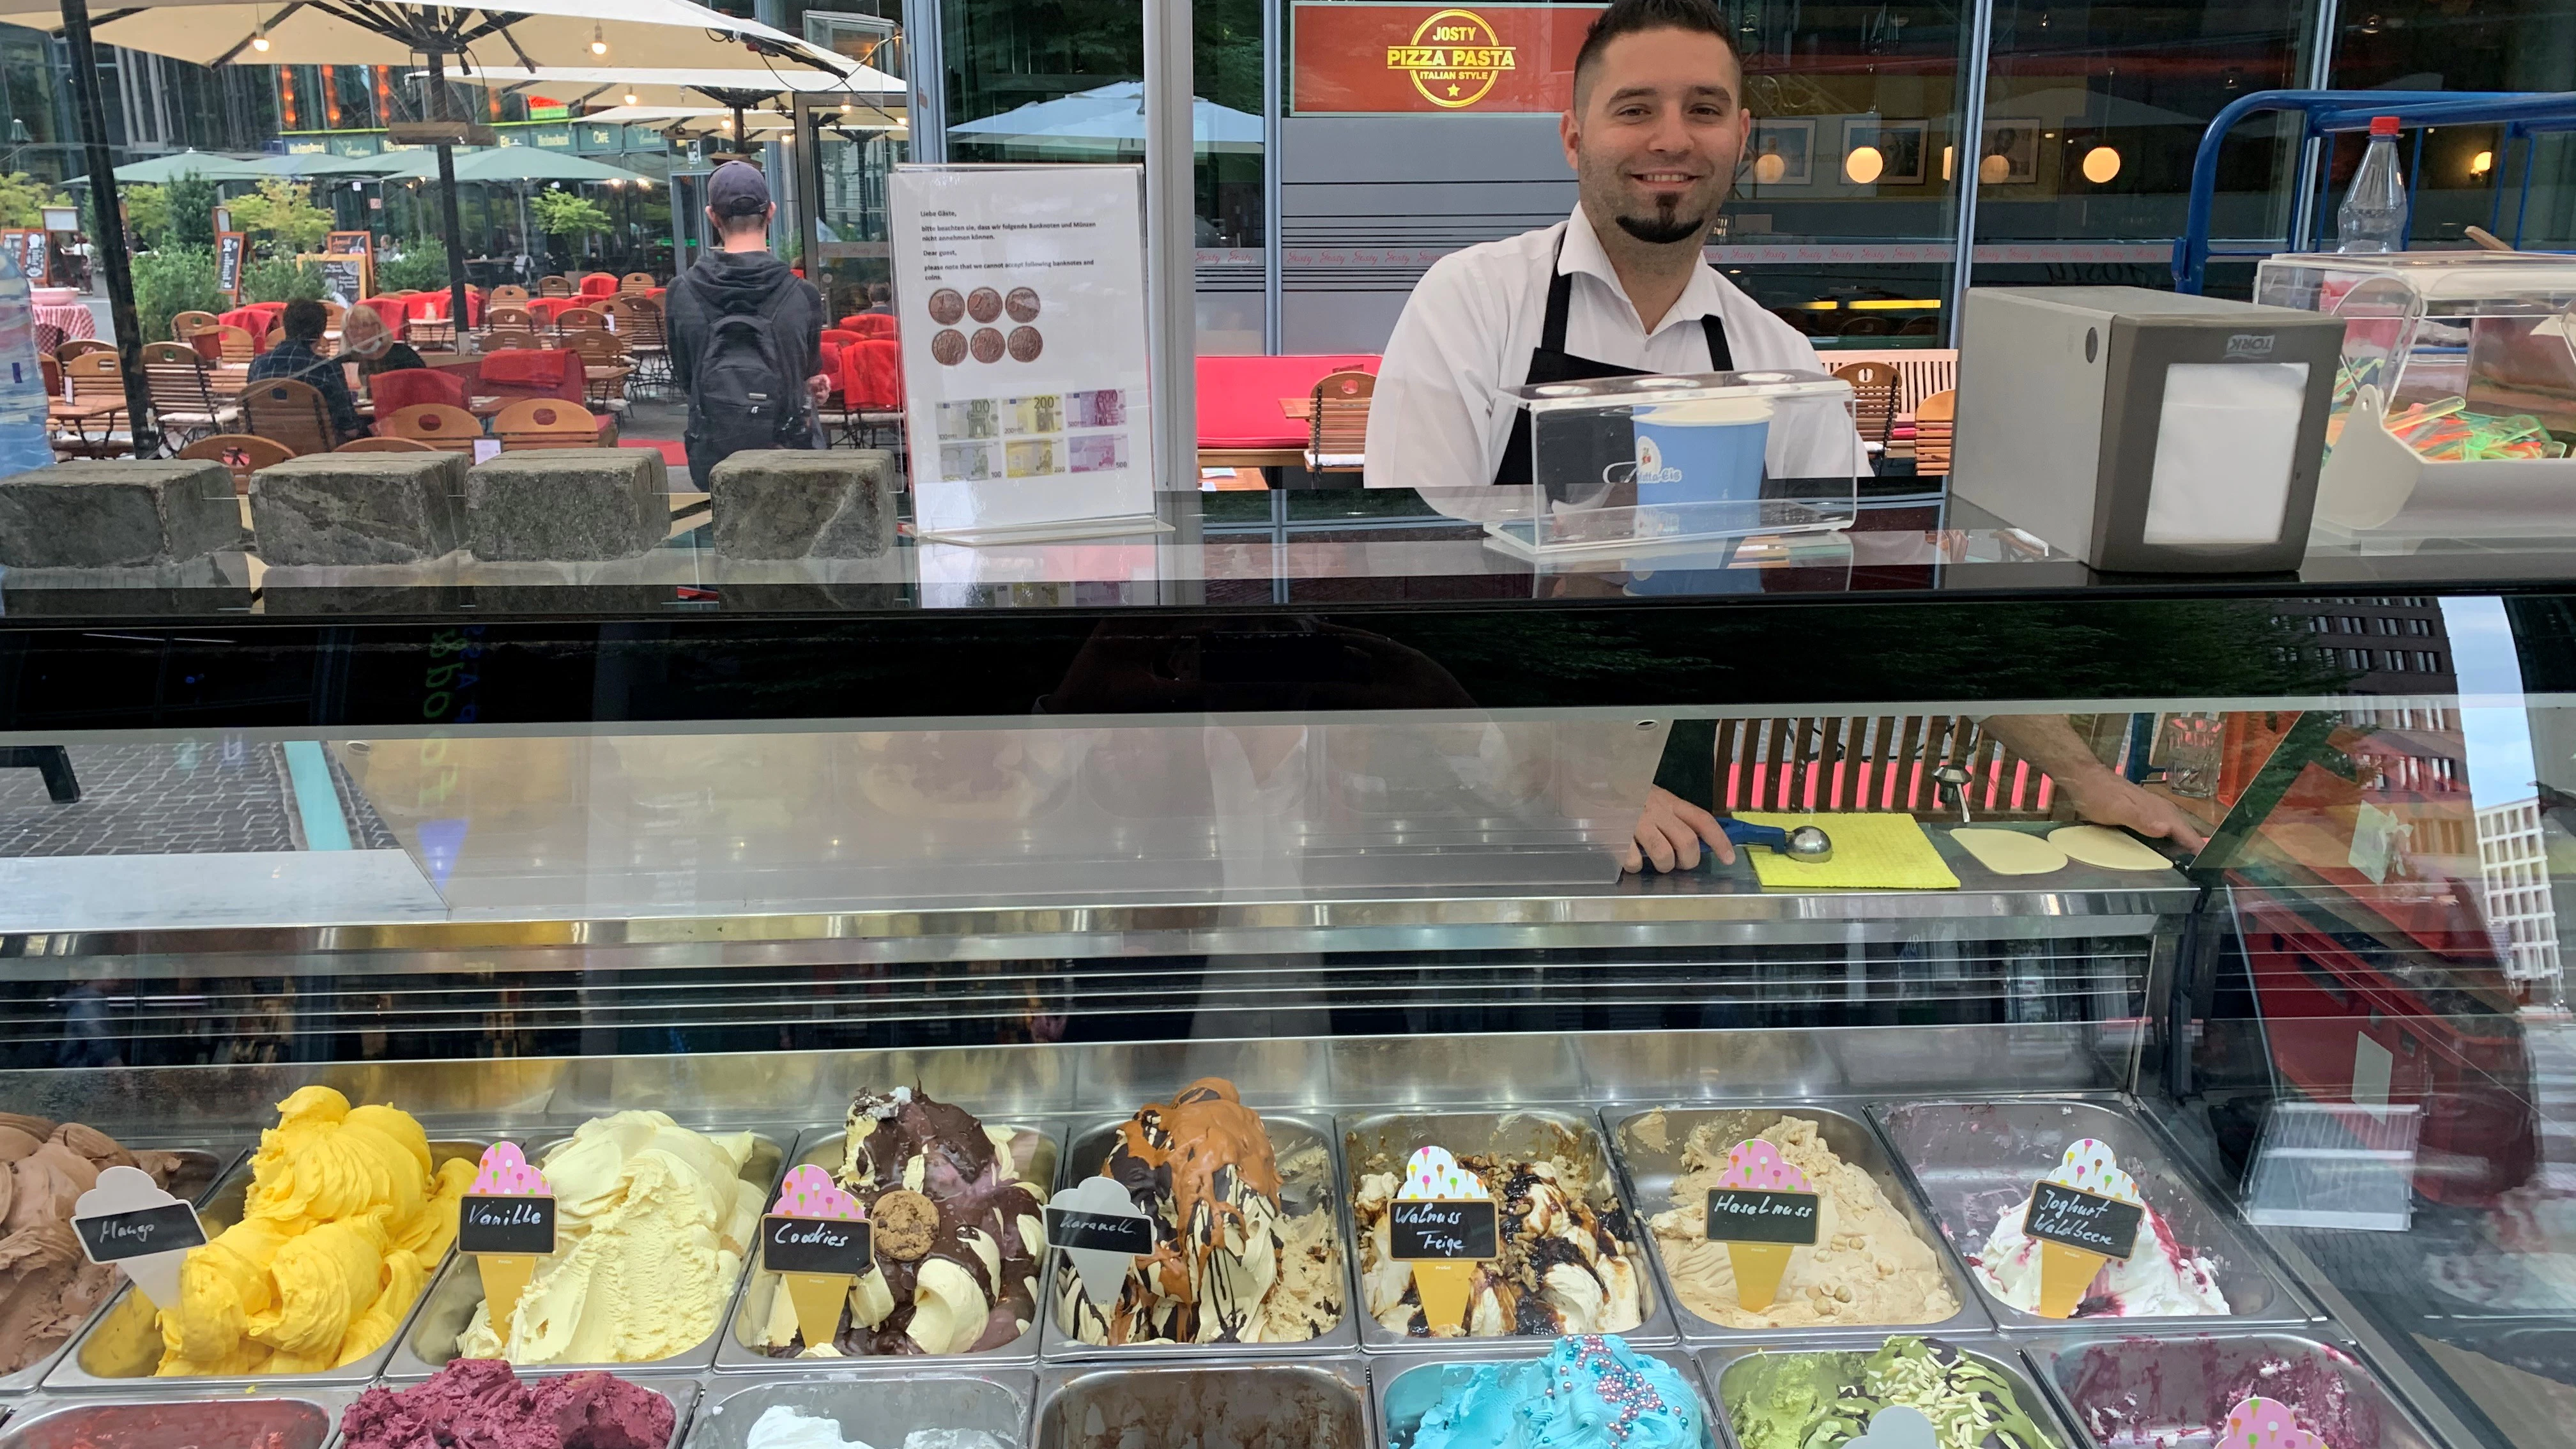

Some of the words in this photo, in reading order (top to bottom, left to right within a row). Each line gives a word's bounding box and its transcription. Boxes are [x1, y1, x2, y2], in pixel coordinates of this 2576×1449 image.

[1432, 27, 1476, 41] JOSTY
[1388, 50, 1445, 66] PIZZA
[1452, 50, 1515, 66] PASTA
[1420, 72, 1456, 80] ITALIAN
[1458, 72, 1488, 80] STYLE
[1002, 223, 1027, 231] folgende
[924, 264, 944, 272] please
[2228, 338, 2272, 350] TORK
[970, 400, 990, 414] 100
[1034, 396, 1054, 410] 200
[1714, 1194, 1813, 1218] Haselnuss
[2039, 1189, 2110, 1219] Joghurt
[469, 1204, 541, 1225] Vanille
[1395, 1202, 1462, 1225] Walnuss
[774, 1223, 848, 1246] Cookies
[1416, 1230, 1466, 1257] Feige
